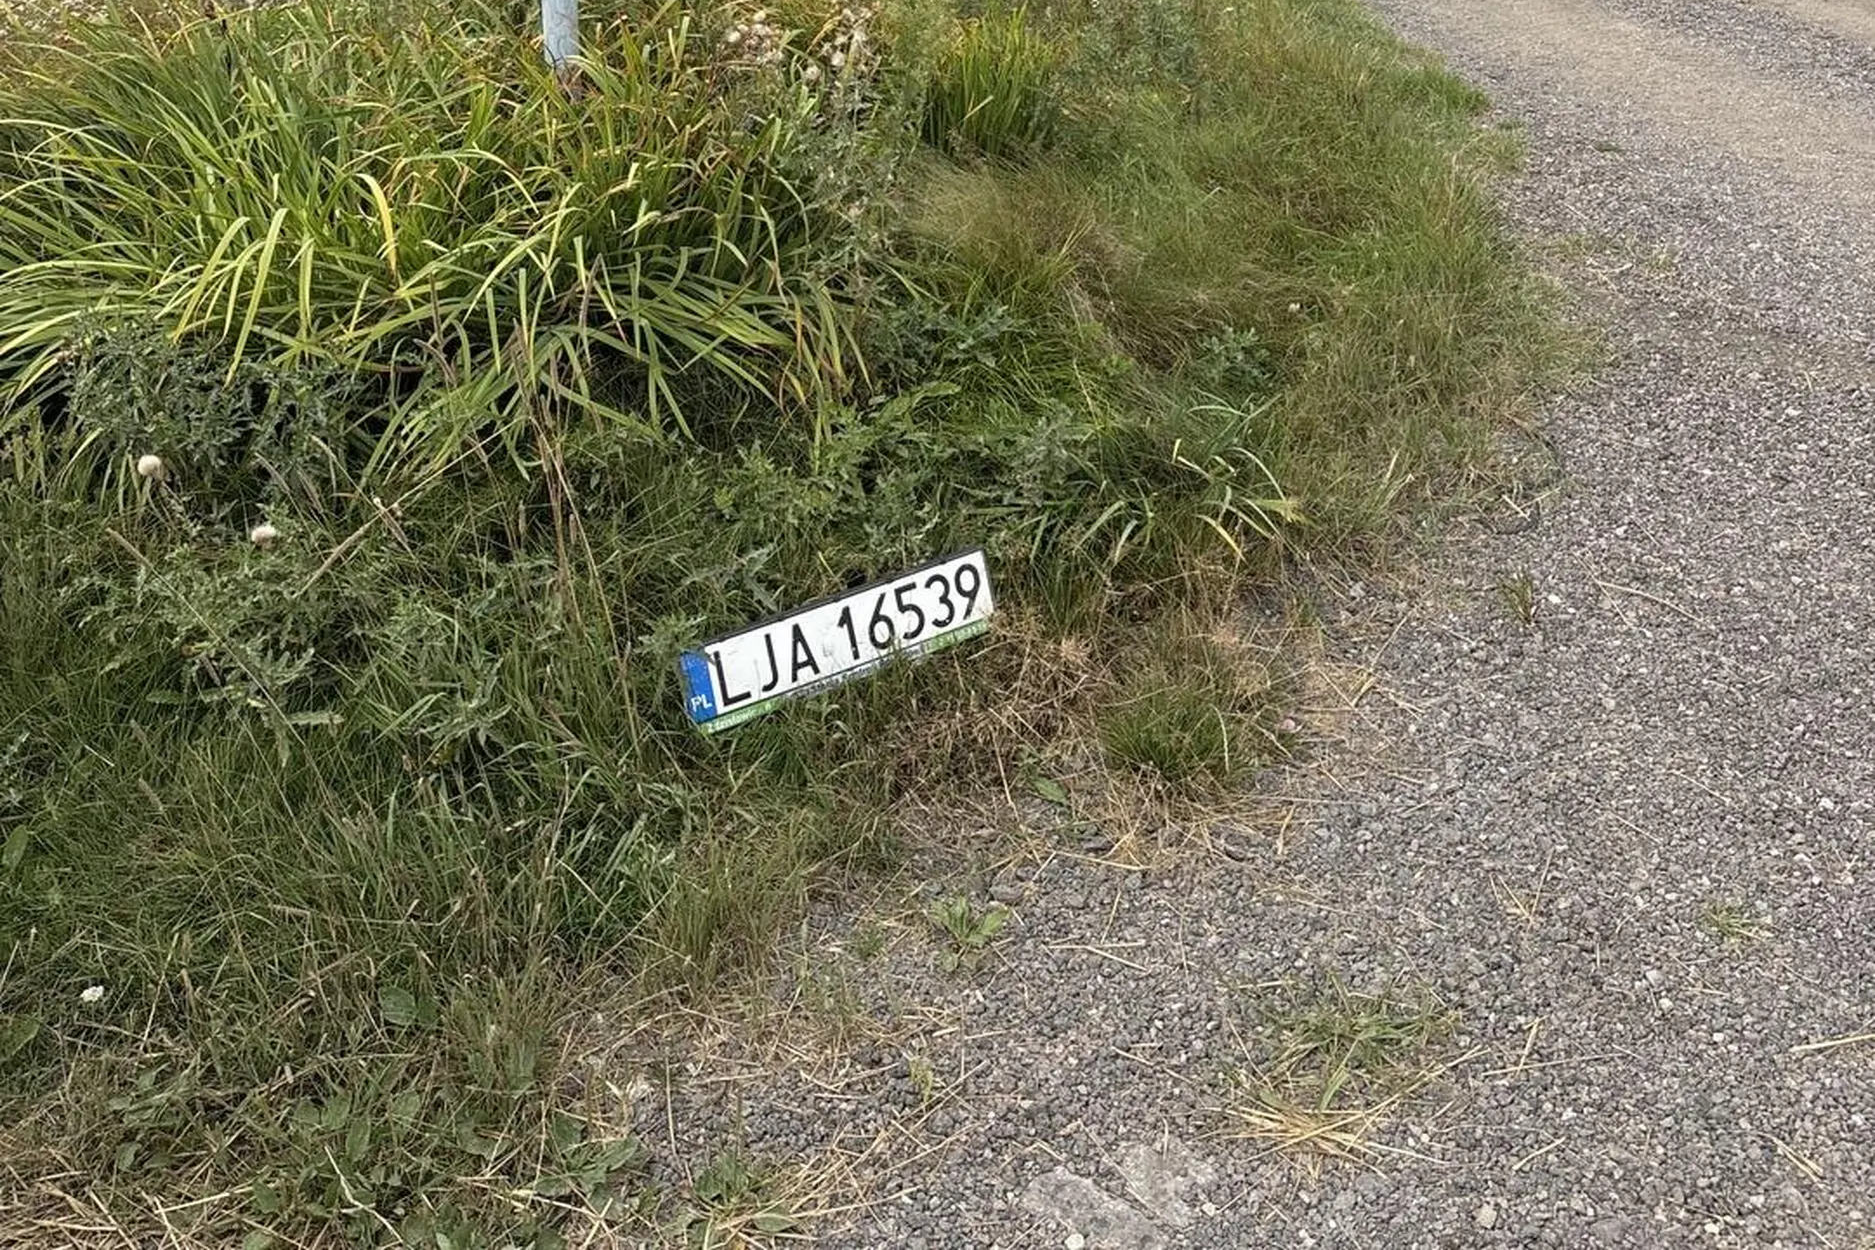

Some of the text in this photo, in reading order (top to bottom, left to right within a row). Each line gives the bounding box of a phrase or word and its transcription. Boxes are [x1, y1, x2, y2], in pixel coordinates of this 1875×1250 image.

[713, 623, 821, 707] LJA
[837, 563, 981, 661] 16539
[690, 694, 713, 712] PL
